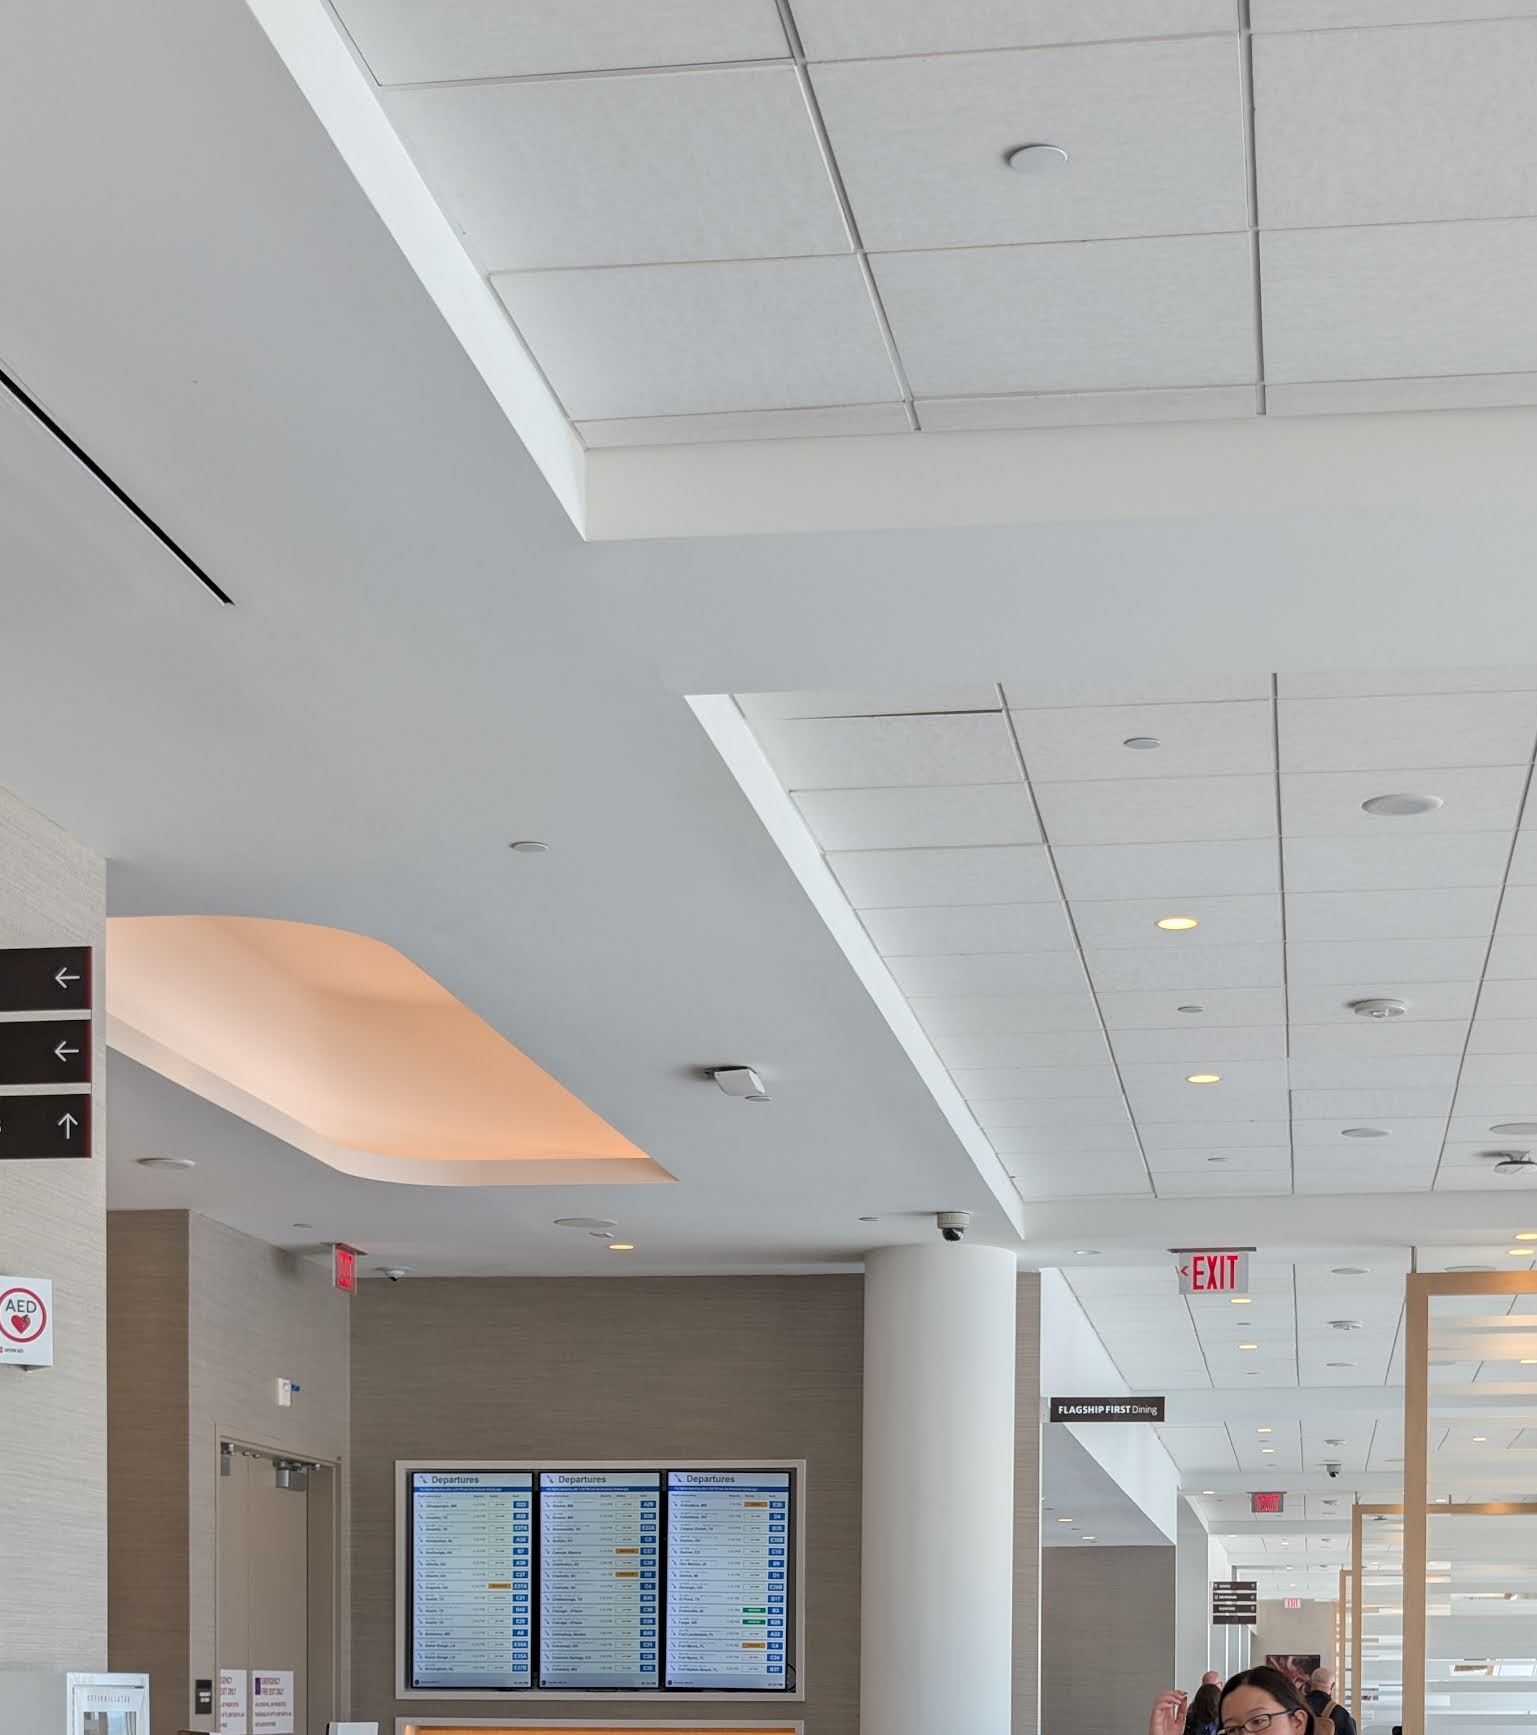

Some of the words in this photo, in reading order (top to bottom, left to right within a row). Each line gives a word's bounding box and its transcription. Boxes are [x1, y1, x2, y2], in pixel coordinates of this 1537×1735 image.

[1192, 1256, 1238, 1290] EXIT
[5, 1298, 37, 1314] AED
[1058, 1405, 1105, 1414] FLAGSHIP
[1106, 1405, 1131, 1414] FIRST
[1132, 1404, 1158, 1416] Dining
[432, 1476, 480, 1485] Departures
[558, 1475, 606, 1484] Departures
[686, 1475, 735, 1484] Departures
